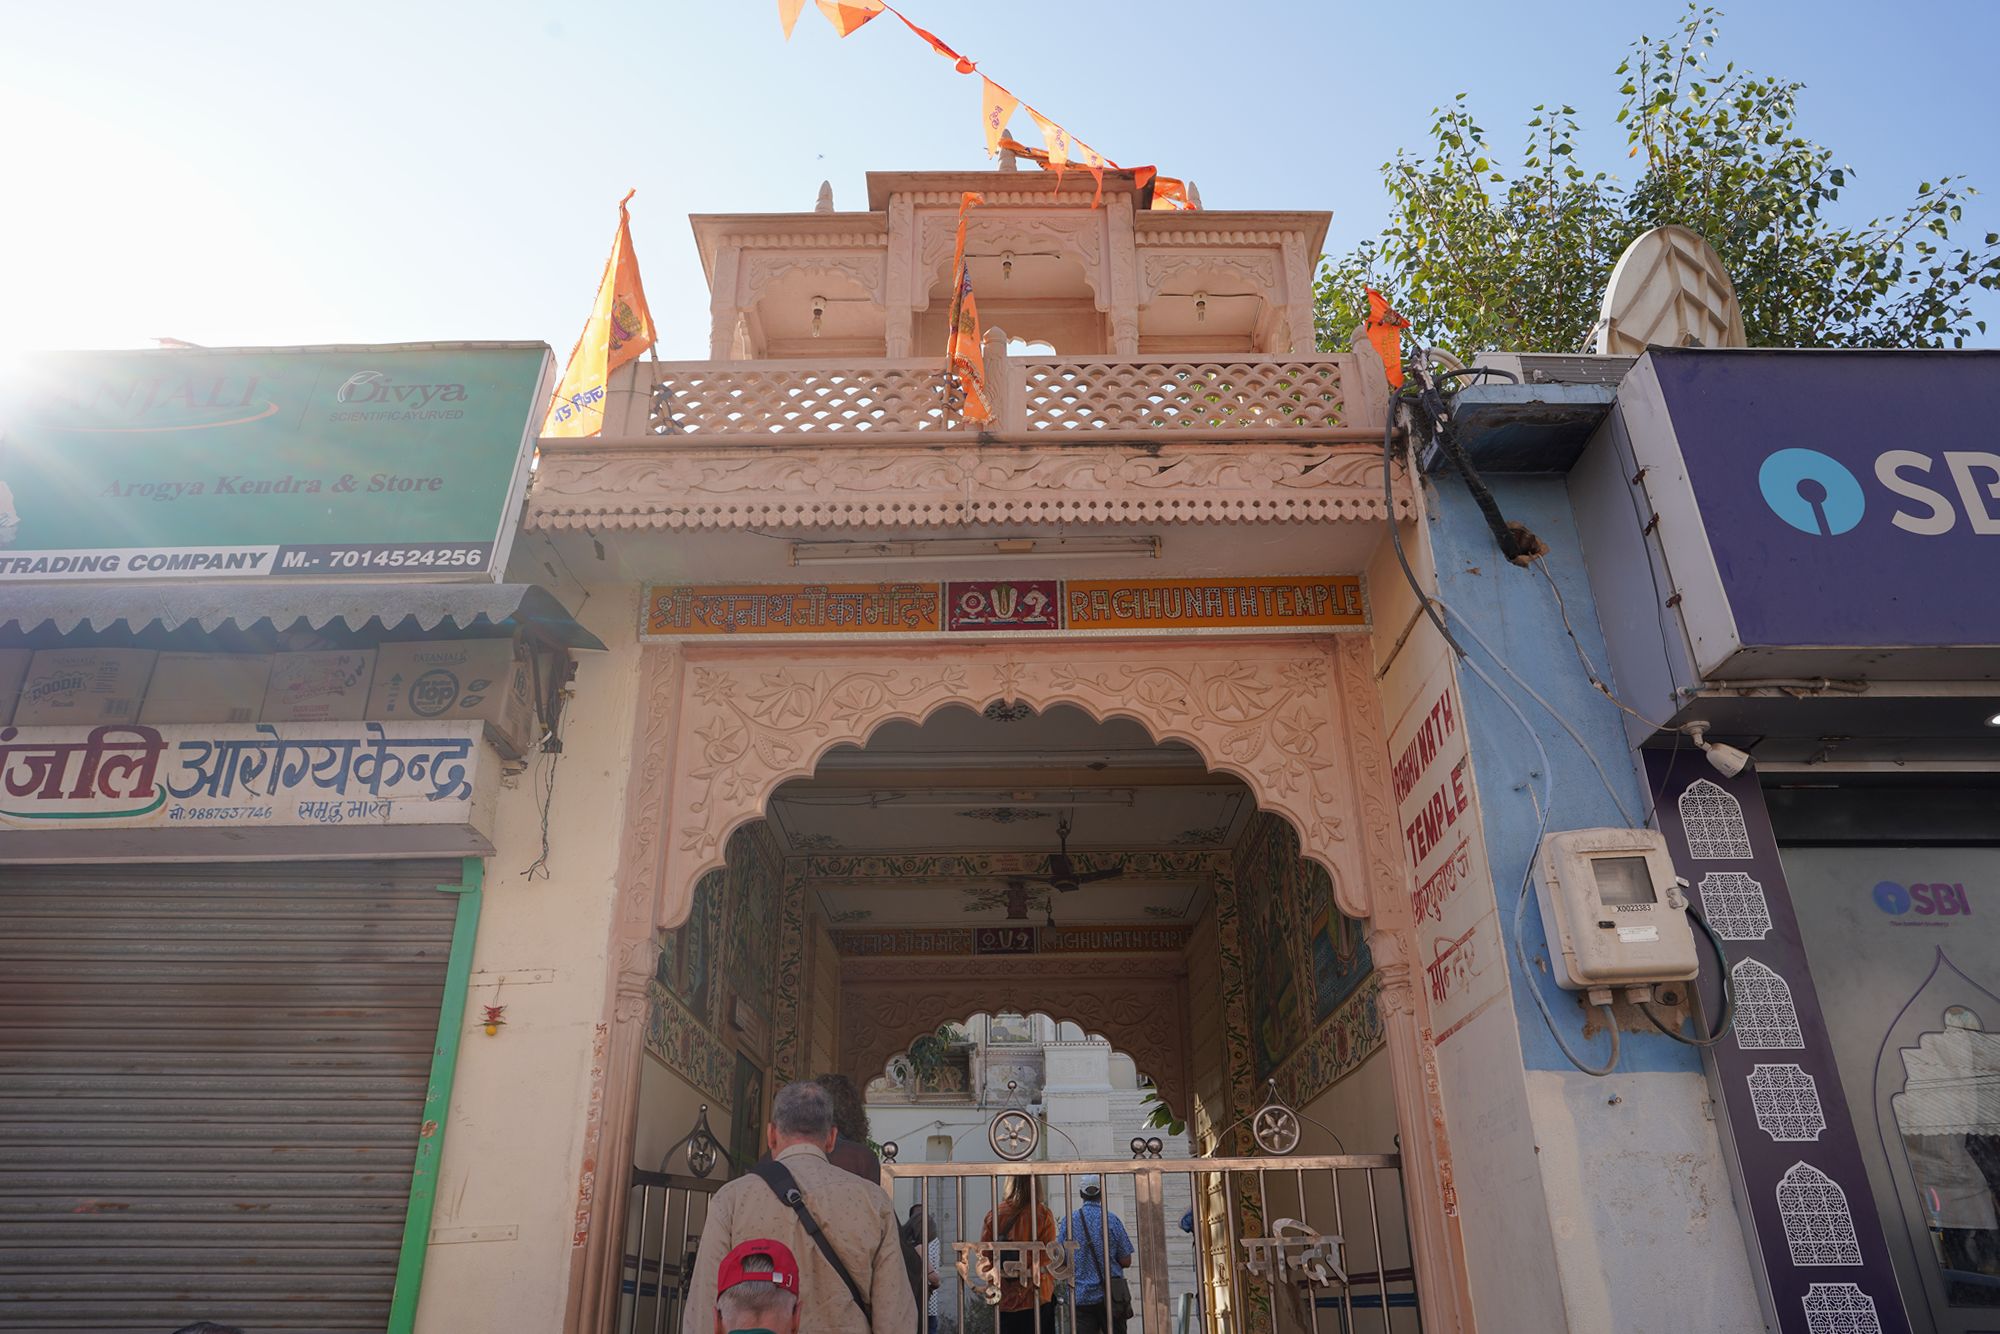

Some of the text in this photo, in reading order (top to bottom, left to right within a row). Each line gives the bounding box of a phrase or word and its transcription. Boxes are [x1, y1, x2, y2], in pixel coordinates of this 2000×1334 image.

[329, 409, 463, 423] SCIENTIFIC AYURVED
[98, 473, 444, 502] Arogya Kendra & Store
[0, 554, 120, 574] TRADING
[127, 552, 267, 573] COMPANY
[328, 548, 482, 568] 7014524256
[1406, 754, 1468, 869] TEMPLE
[1909, 883, 1972, 915] SBI
